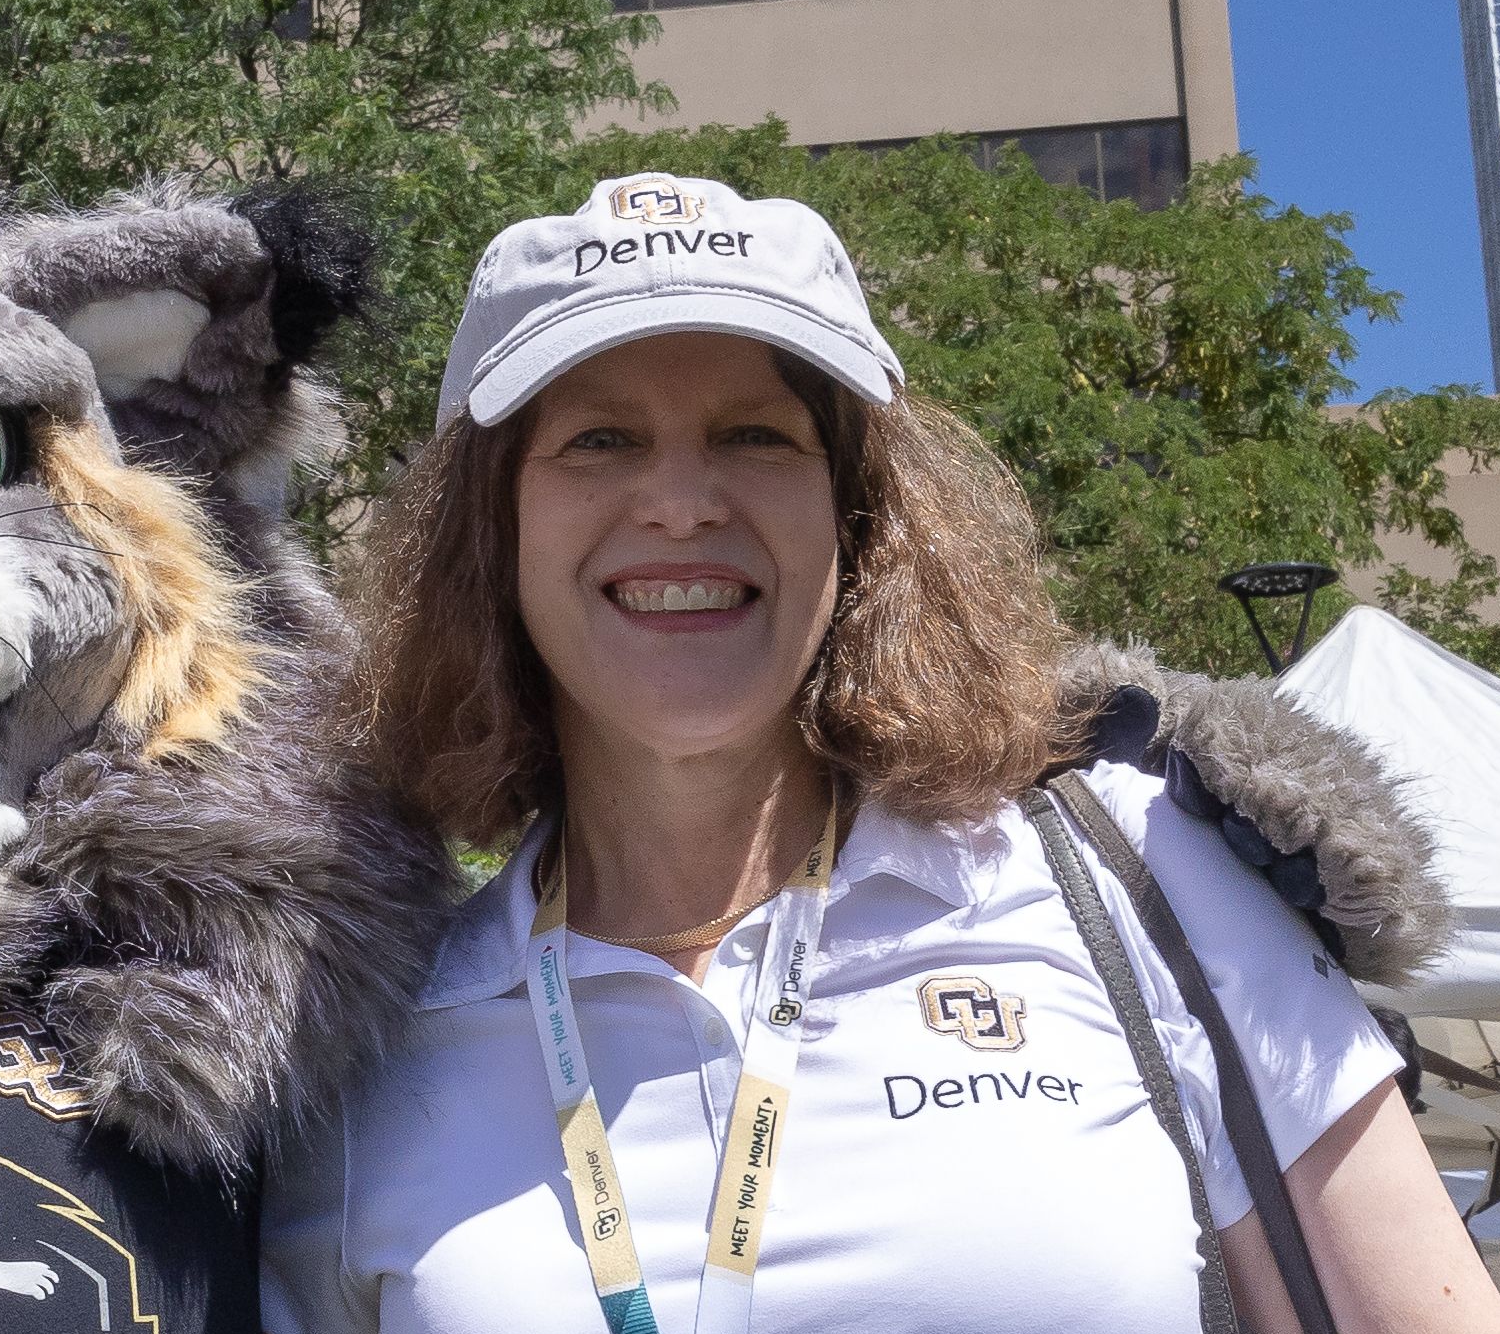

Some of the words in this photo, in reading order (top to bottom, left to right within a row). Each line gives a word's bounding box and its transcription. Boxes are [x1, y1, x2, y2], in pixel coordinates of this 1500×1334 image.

[573, 228, 753, 277] Denver
[541, 953, 560, 1008] MOMENT
[782, 938, 807, 992] Denver
[551, 1012, 568, 1047] YOUR
[917, 974, 1026, 1053] CU
[559, 1051, 577, 1087] MEET
[884, 1067, 1085, 1121] Denver
[748, 1104, 772, 1168] MOMENT
[585, 1148, 611, 1207] Denver
[738, 1173, 758, 1214] YOUR
[728, 1218, 749, 1257] MEET
